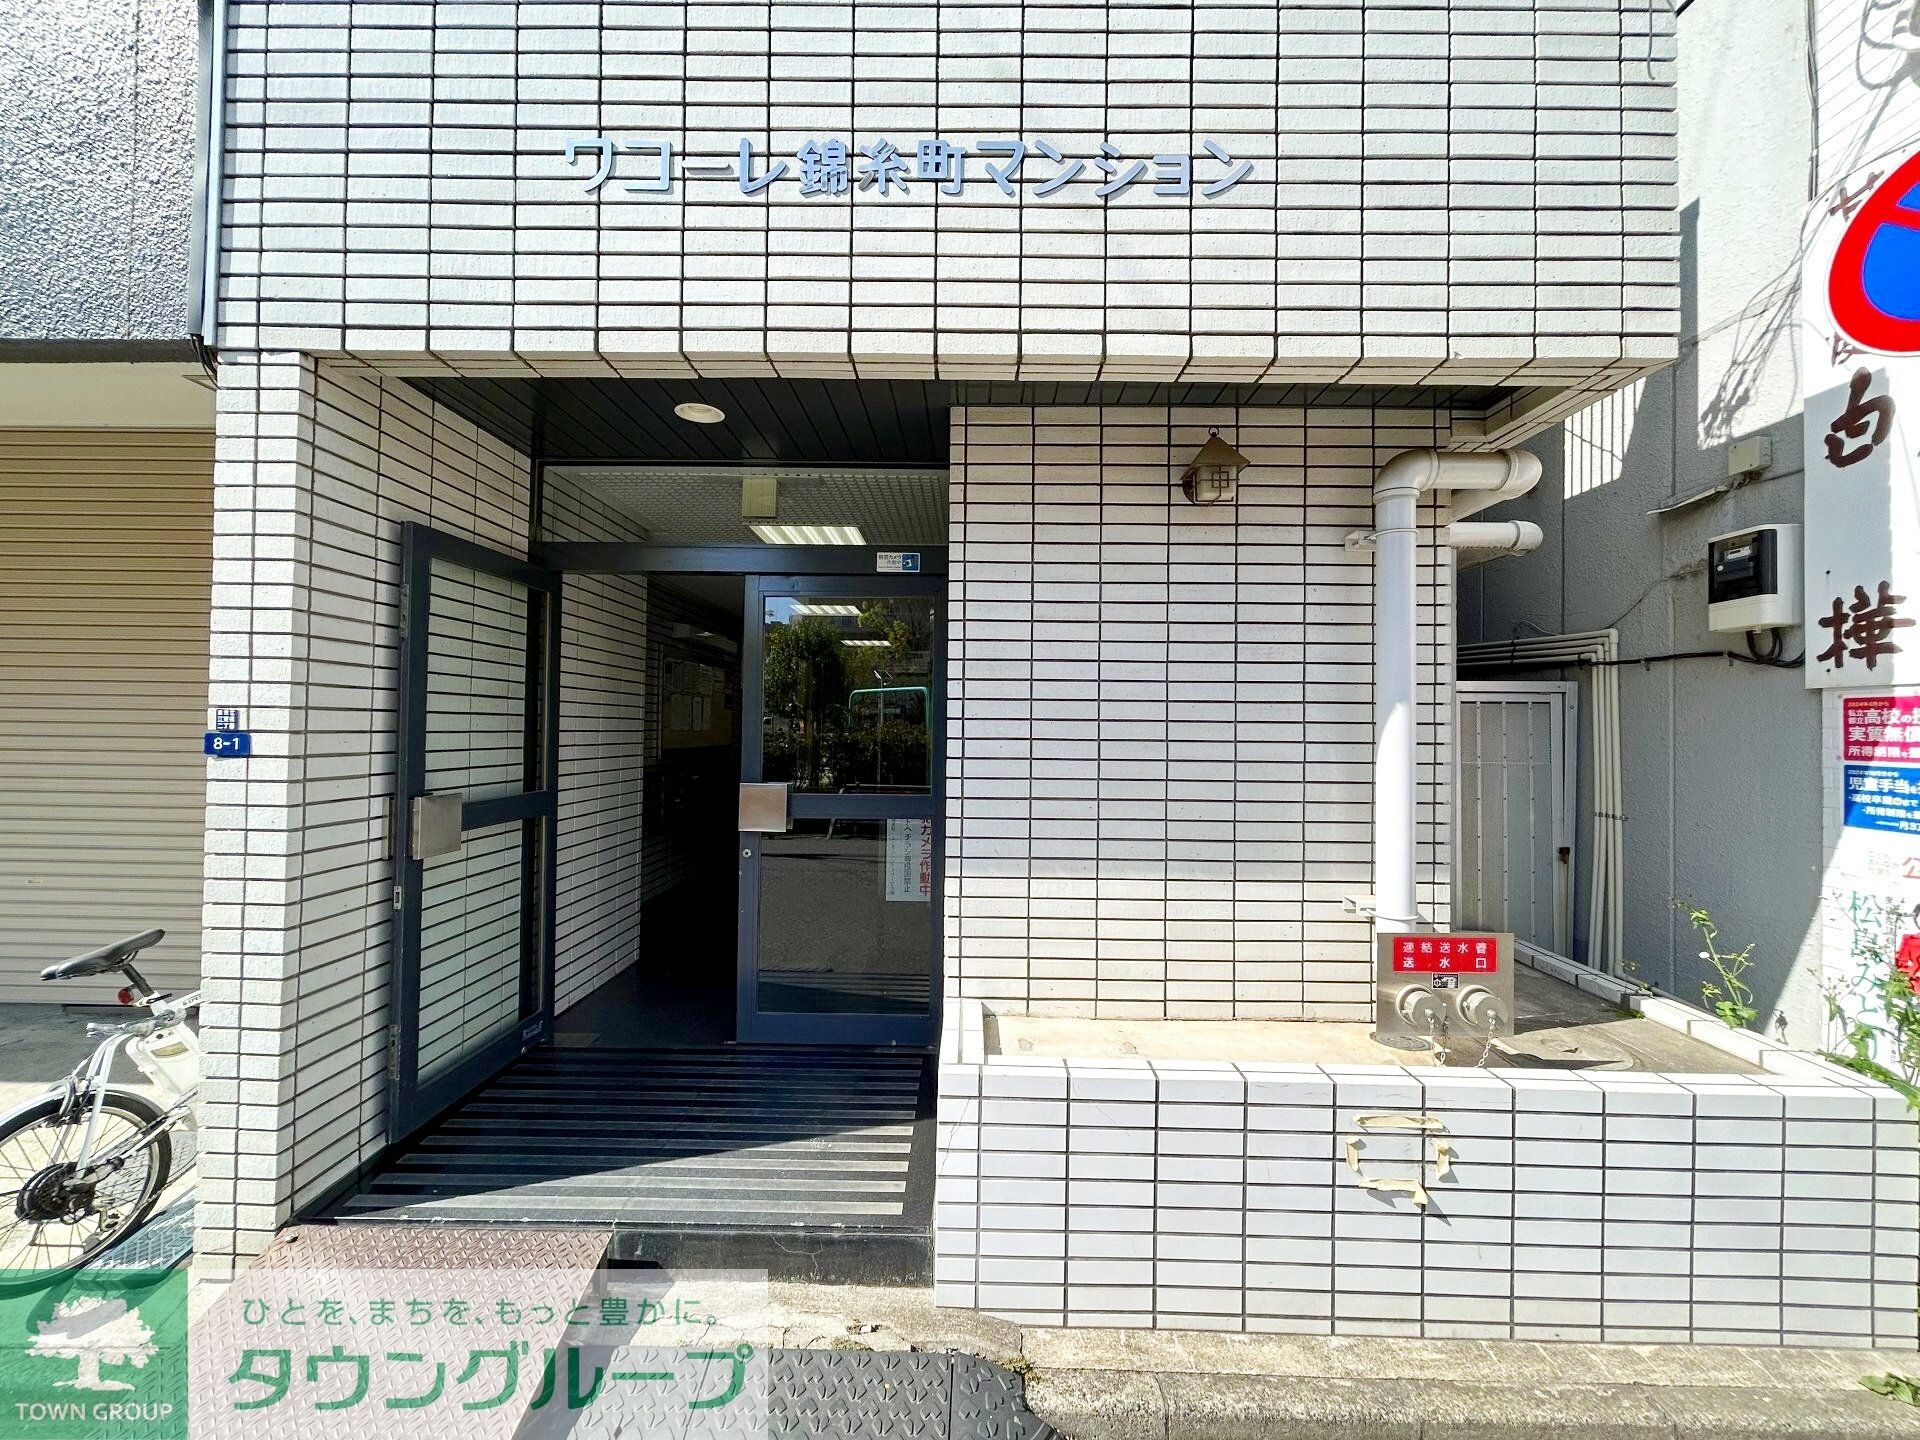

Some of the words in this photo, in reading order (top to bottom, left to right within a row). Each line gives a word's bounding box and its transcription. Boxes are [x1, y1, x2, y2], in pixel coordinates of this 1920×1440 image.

[564, 137, 1254, 197] ワコーレ錦糸町マンション
[213, 736, 240, 750] 8-1
[1848, 776, 1920, 795] 児童手当を
[1403, 942, 1487, 955] 連結送水管
[1403, 957, 1487, 969] 送水口
